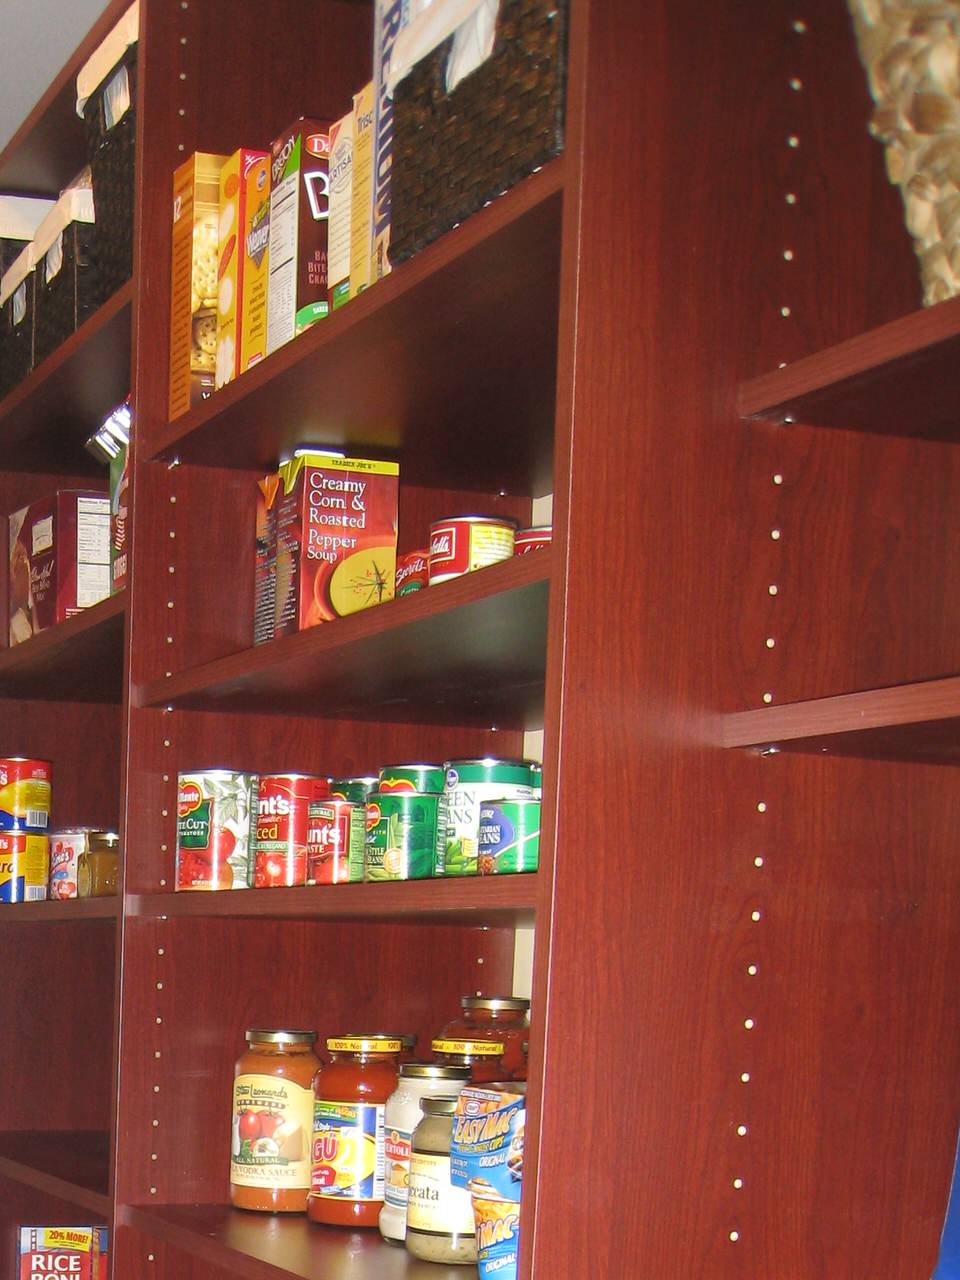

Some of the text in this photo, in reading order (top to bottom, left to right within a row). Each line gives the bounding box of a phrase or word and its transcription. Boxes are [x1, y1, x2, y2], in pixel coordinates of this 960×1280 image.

[310, 472, 367, 496] Creamy
[309, 490, 366, 511] Corn &
[309, 507, 366, 529] Roasted
[309, 528, 357, 550] Pepper
[307, 545, 338, 563] Soup
[481, 1106, 518, 1140] MAC
[49, 1230, 89, 1244] 20% MORE!
[31, 1254, 82, 1272] RICE
